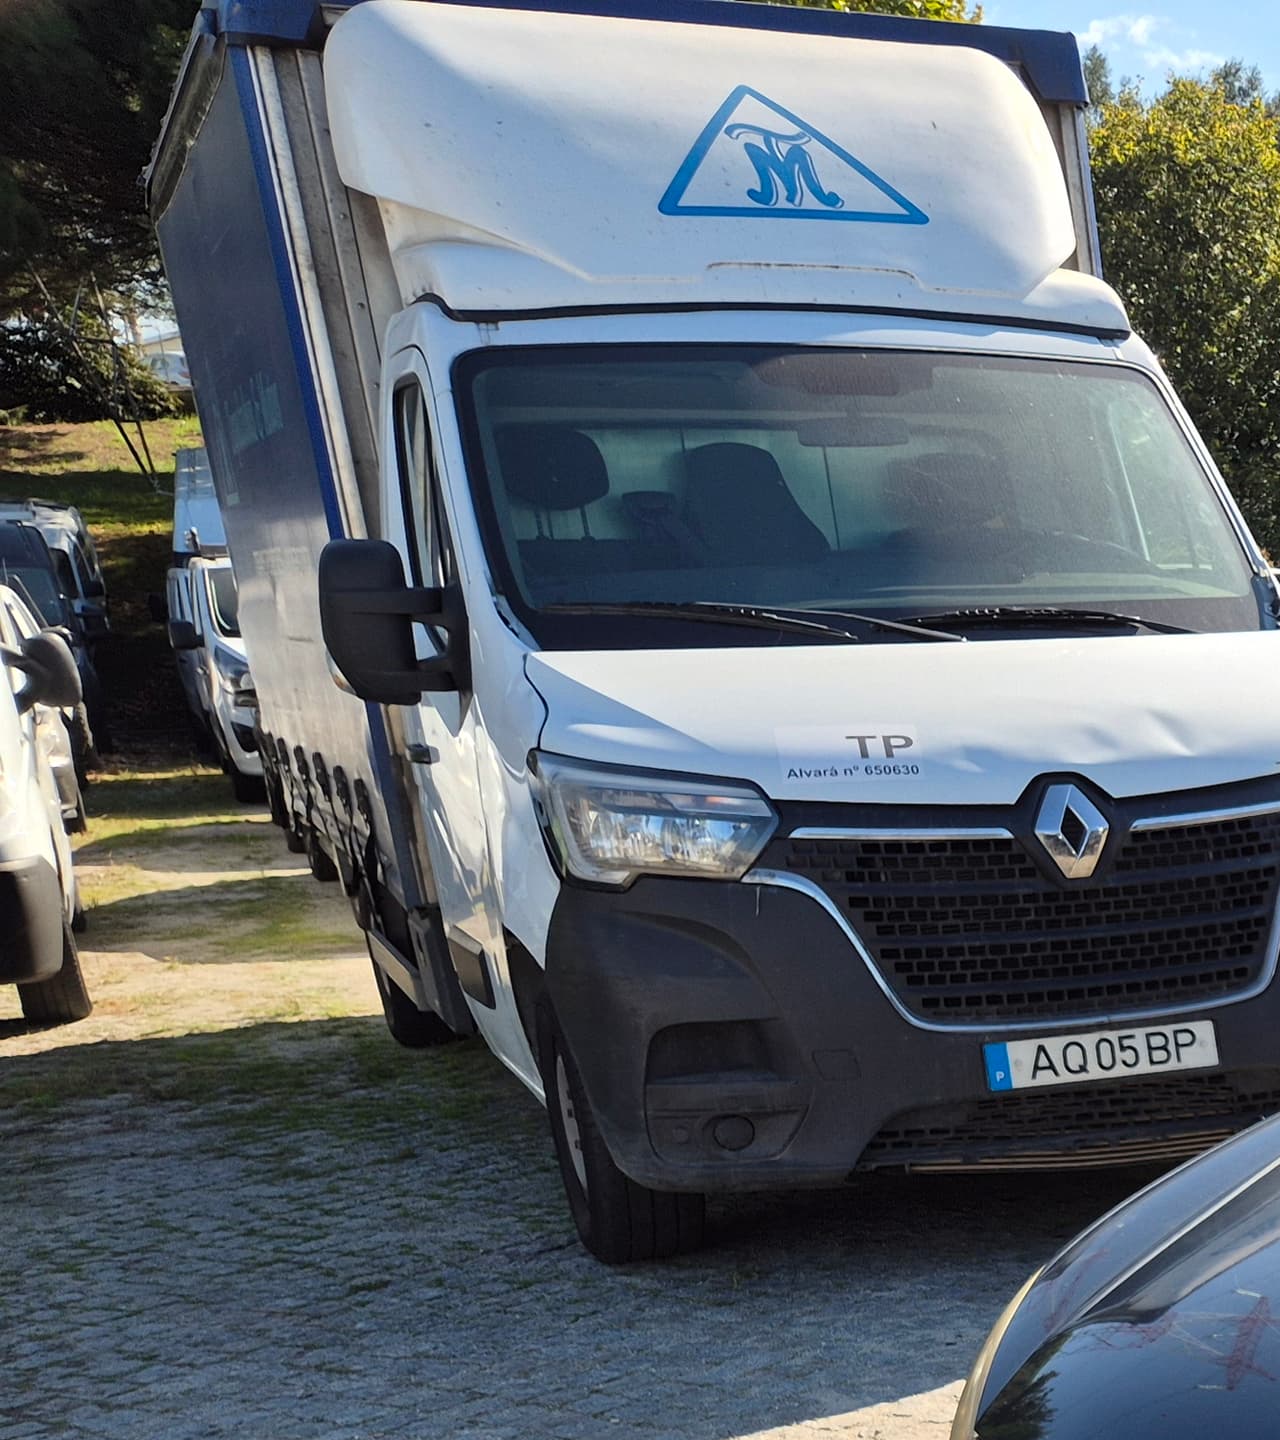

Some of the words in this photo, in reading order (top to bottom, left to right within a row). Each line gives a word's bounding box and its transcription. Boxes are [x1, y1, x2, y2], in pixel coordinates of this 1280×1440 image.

[845, 735, 914, 759] TP
[787, 767, 839, 779] Alvará
[864, 764, 920, 776] 650630
[996, 1071, 1005, 1083] P
